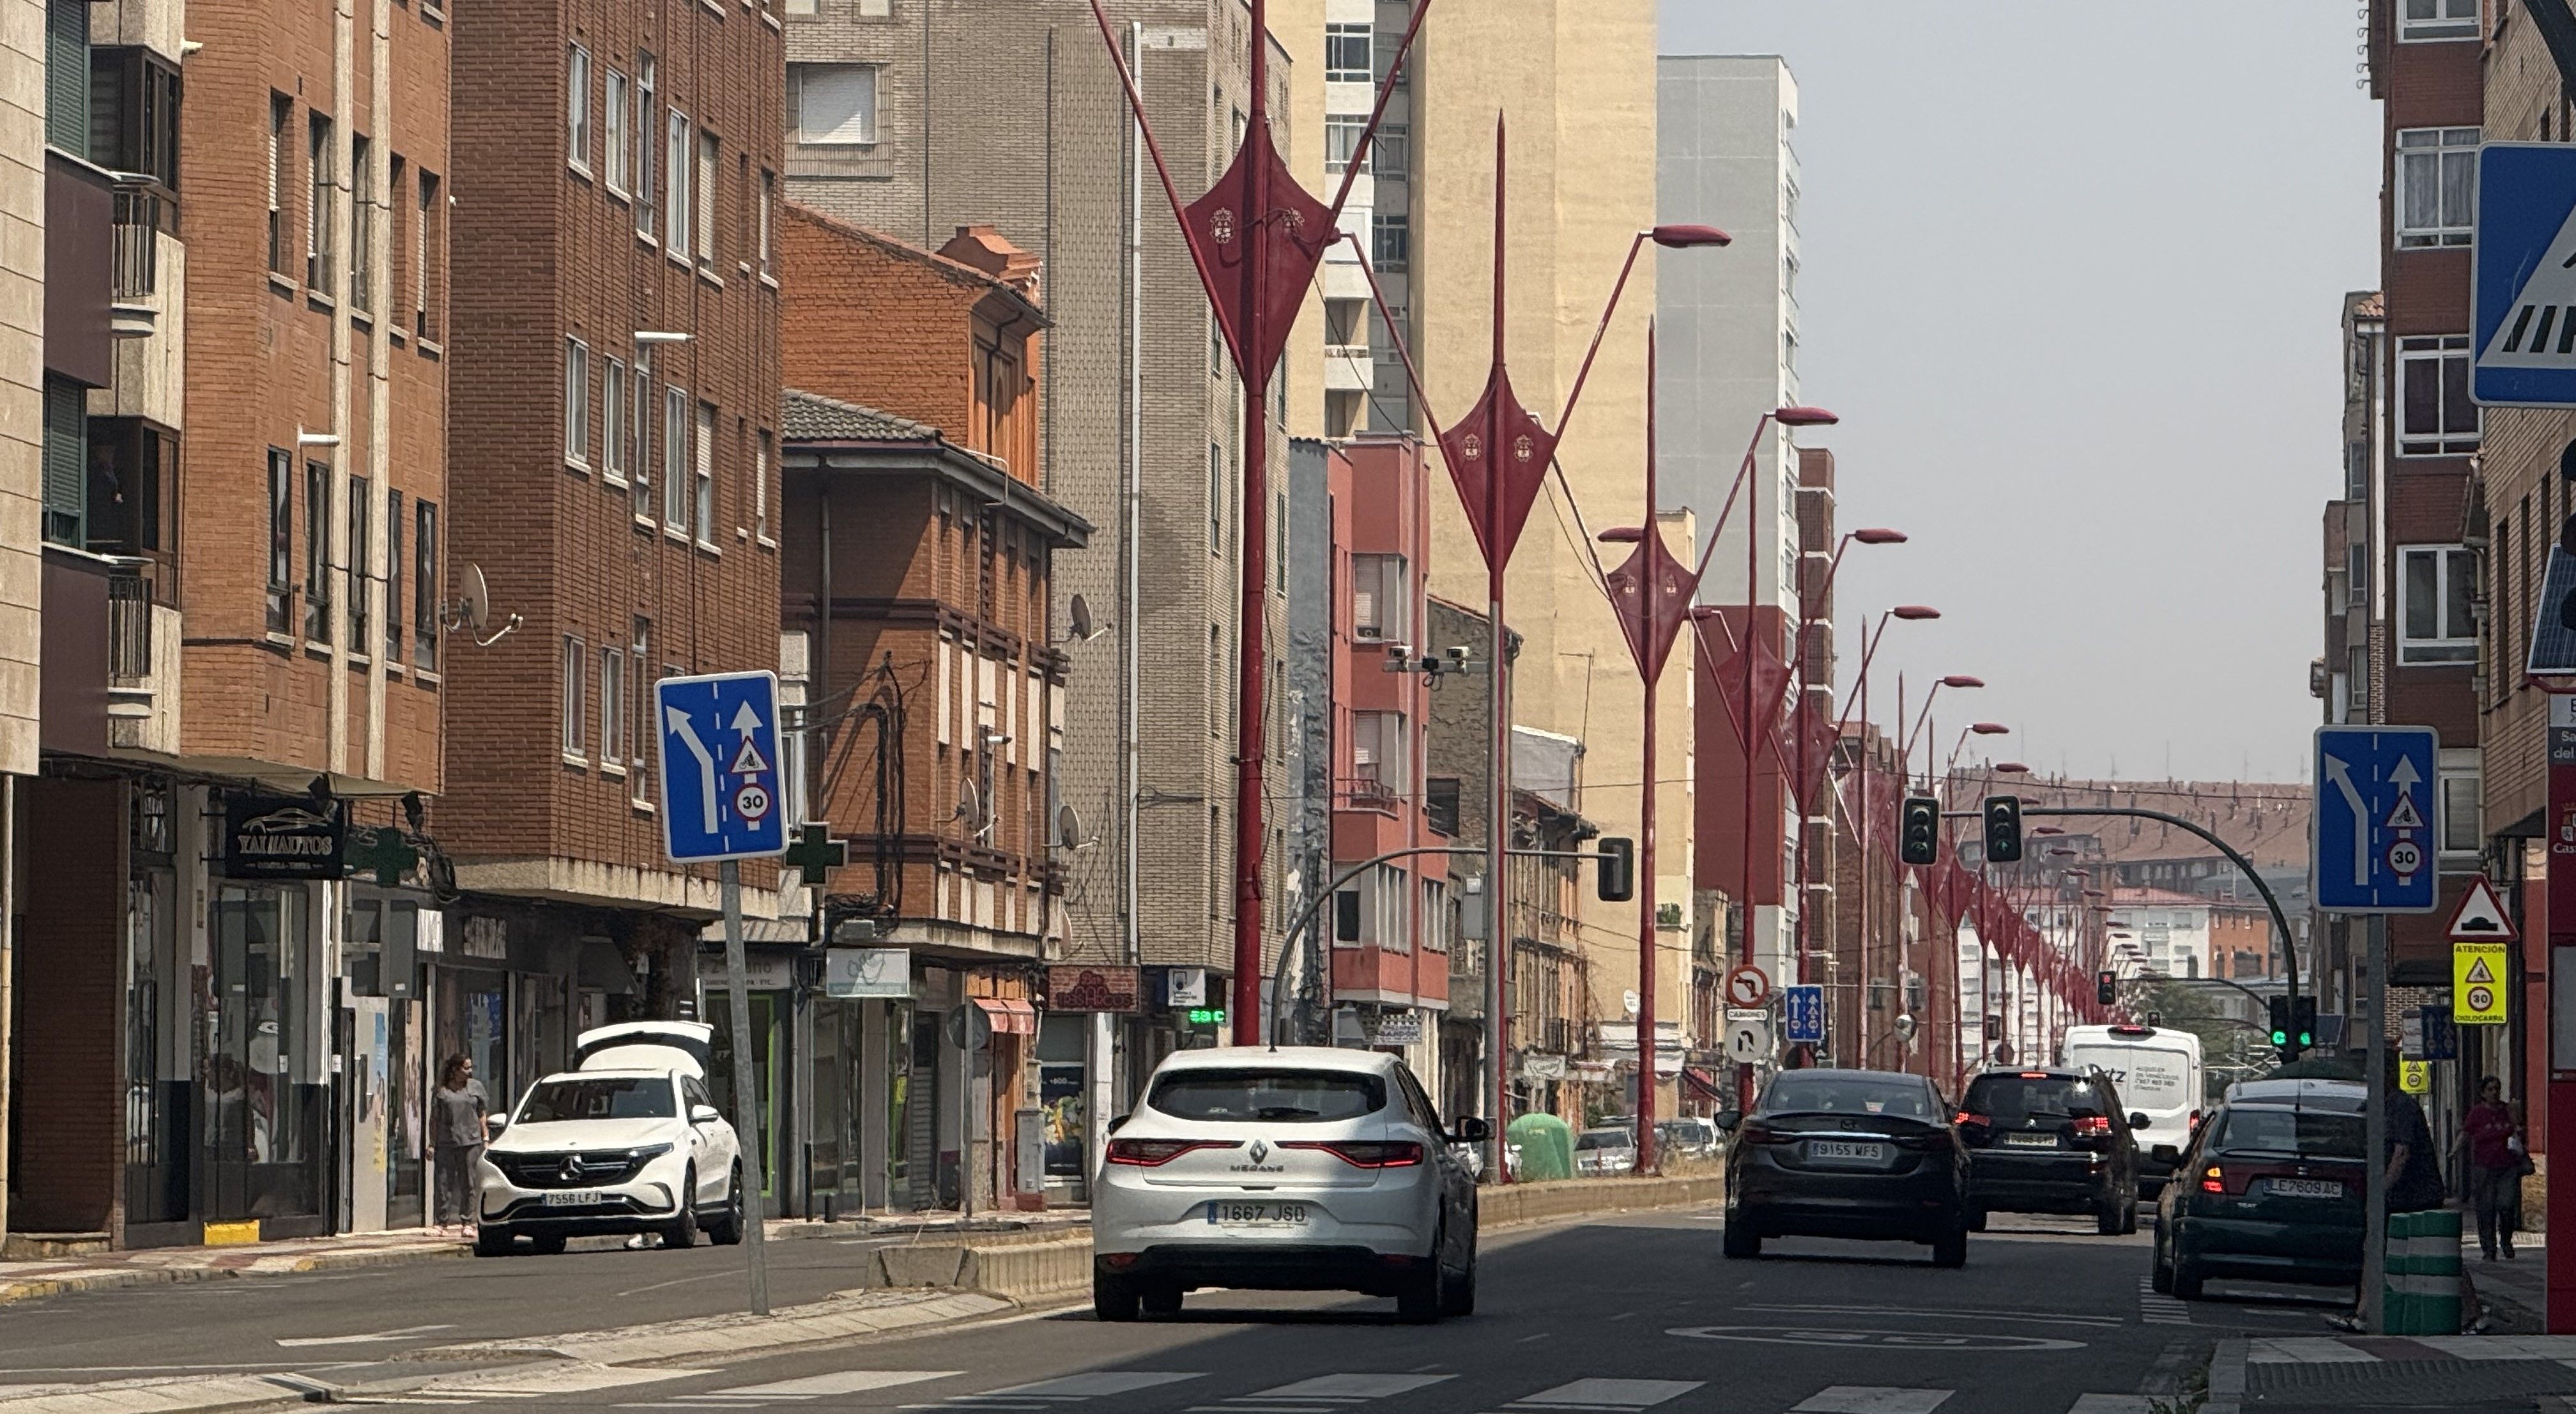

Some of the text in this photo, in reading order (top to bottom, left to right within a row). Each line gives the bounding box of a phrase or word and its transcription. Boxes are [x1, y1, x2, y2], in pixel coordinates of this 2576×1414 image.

[2554, 746, 2574, 758] del
[743, 795, 763, 810] 30
[2395, 851, 2416, 865] 30
[2473, 994, 2488, 1004] 30
[1222, 1205, 1265, 1221] 1667
